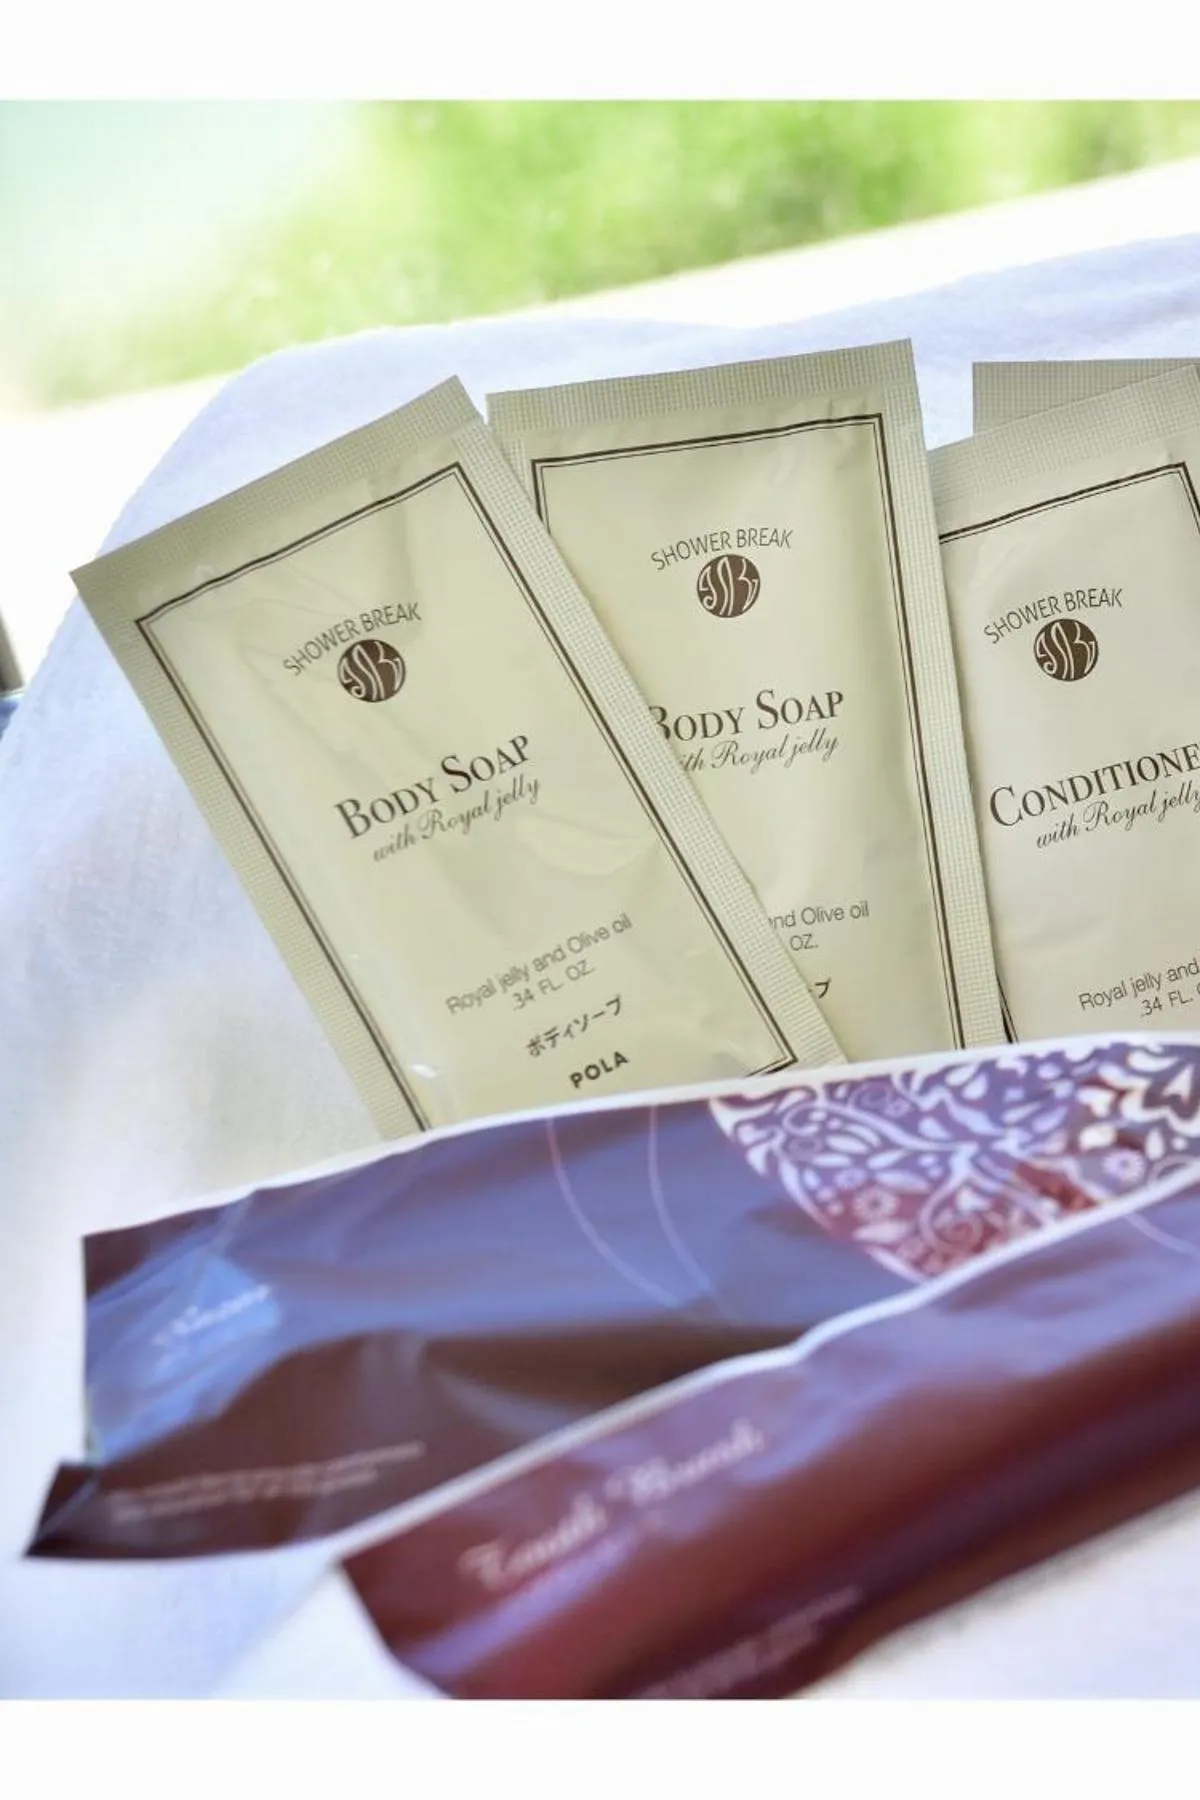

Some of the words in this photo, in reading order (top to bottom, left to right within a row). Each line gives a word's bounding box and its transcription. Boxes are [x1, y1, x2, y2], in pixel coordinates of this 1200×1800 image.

[650, 530, 732, 571] SHOWER
[736, 527, 793, 549] BREAK
[282, 619, 361, 677] SHOWER
[359, 602, 421, 633] BREAK
[983, 596, 1061, 644] SHOWER
[1064, 588, 1123, 612] BREAK
[756, 688, 844, 730] SOAP
[681, 747, 704, 771] ith
[711, 733, 790, 774] Royal
[784, 727, 839, 769] jelly
[334, 777, 440, 839] BODY
[440, 735, 529, 794] SOAP
[373, 824, 417, 861] with
[416, 790, 491, 840] Royal
[493, 774, 540, 821] jelly
[1036, 812, 1080, 849] with
[1082, 790, 1156, 832] Royal
[801, 906, 845, 925] Olive
[849, 899, 869, 919] oil
[445, 978, 497, 1014] Royal
[497, 964, 530, 994] jelly
[532, 945, 566, 972] and
[567, 927, 610, 953] Olive
[611, 912, 632, 933] oil
[789, 934, 819, 951] OZ.
[512, 988, 534, 1011] .34
[1078, 981, 1127, 1011] Royal
[1129, 972, 1162, 999] jelly
[1167, 958, 1200, 983] and
[1140, 996, 1162, 1017] .34
[1168, 990, 1193, 1008] FL.
[570, 1051, 629, 1089] POLA
